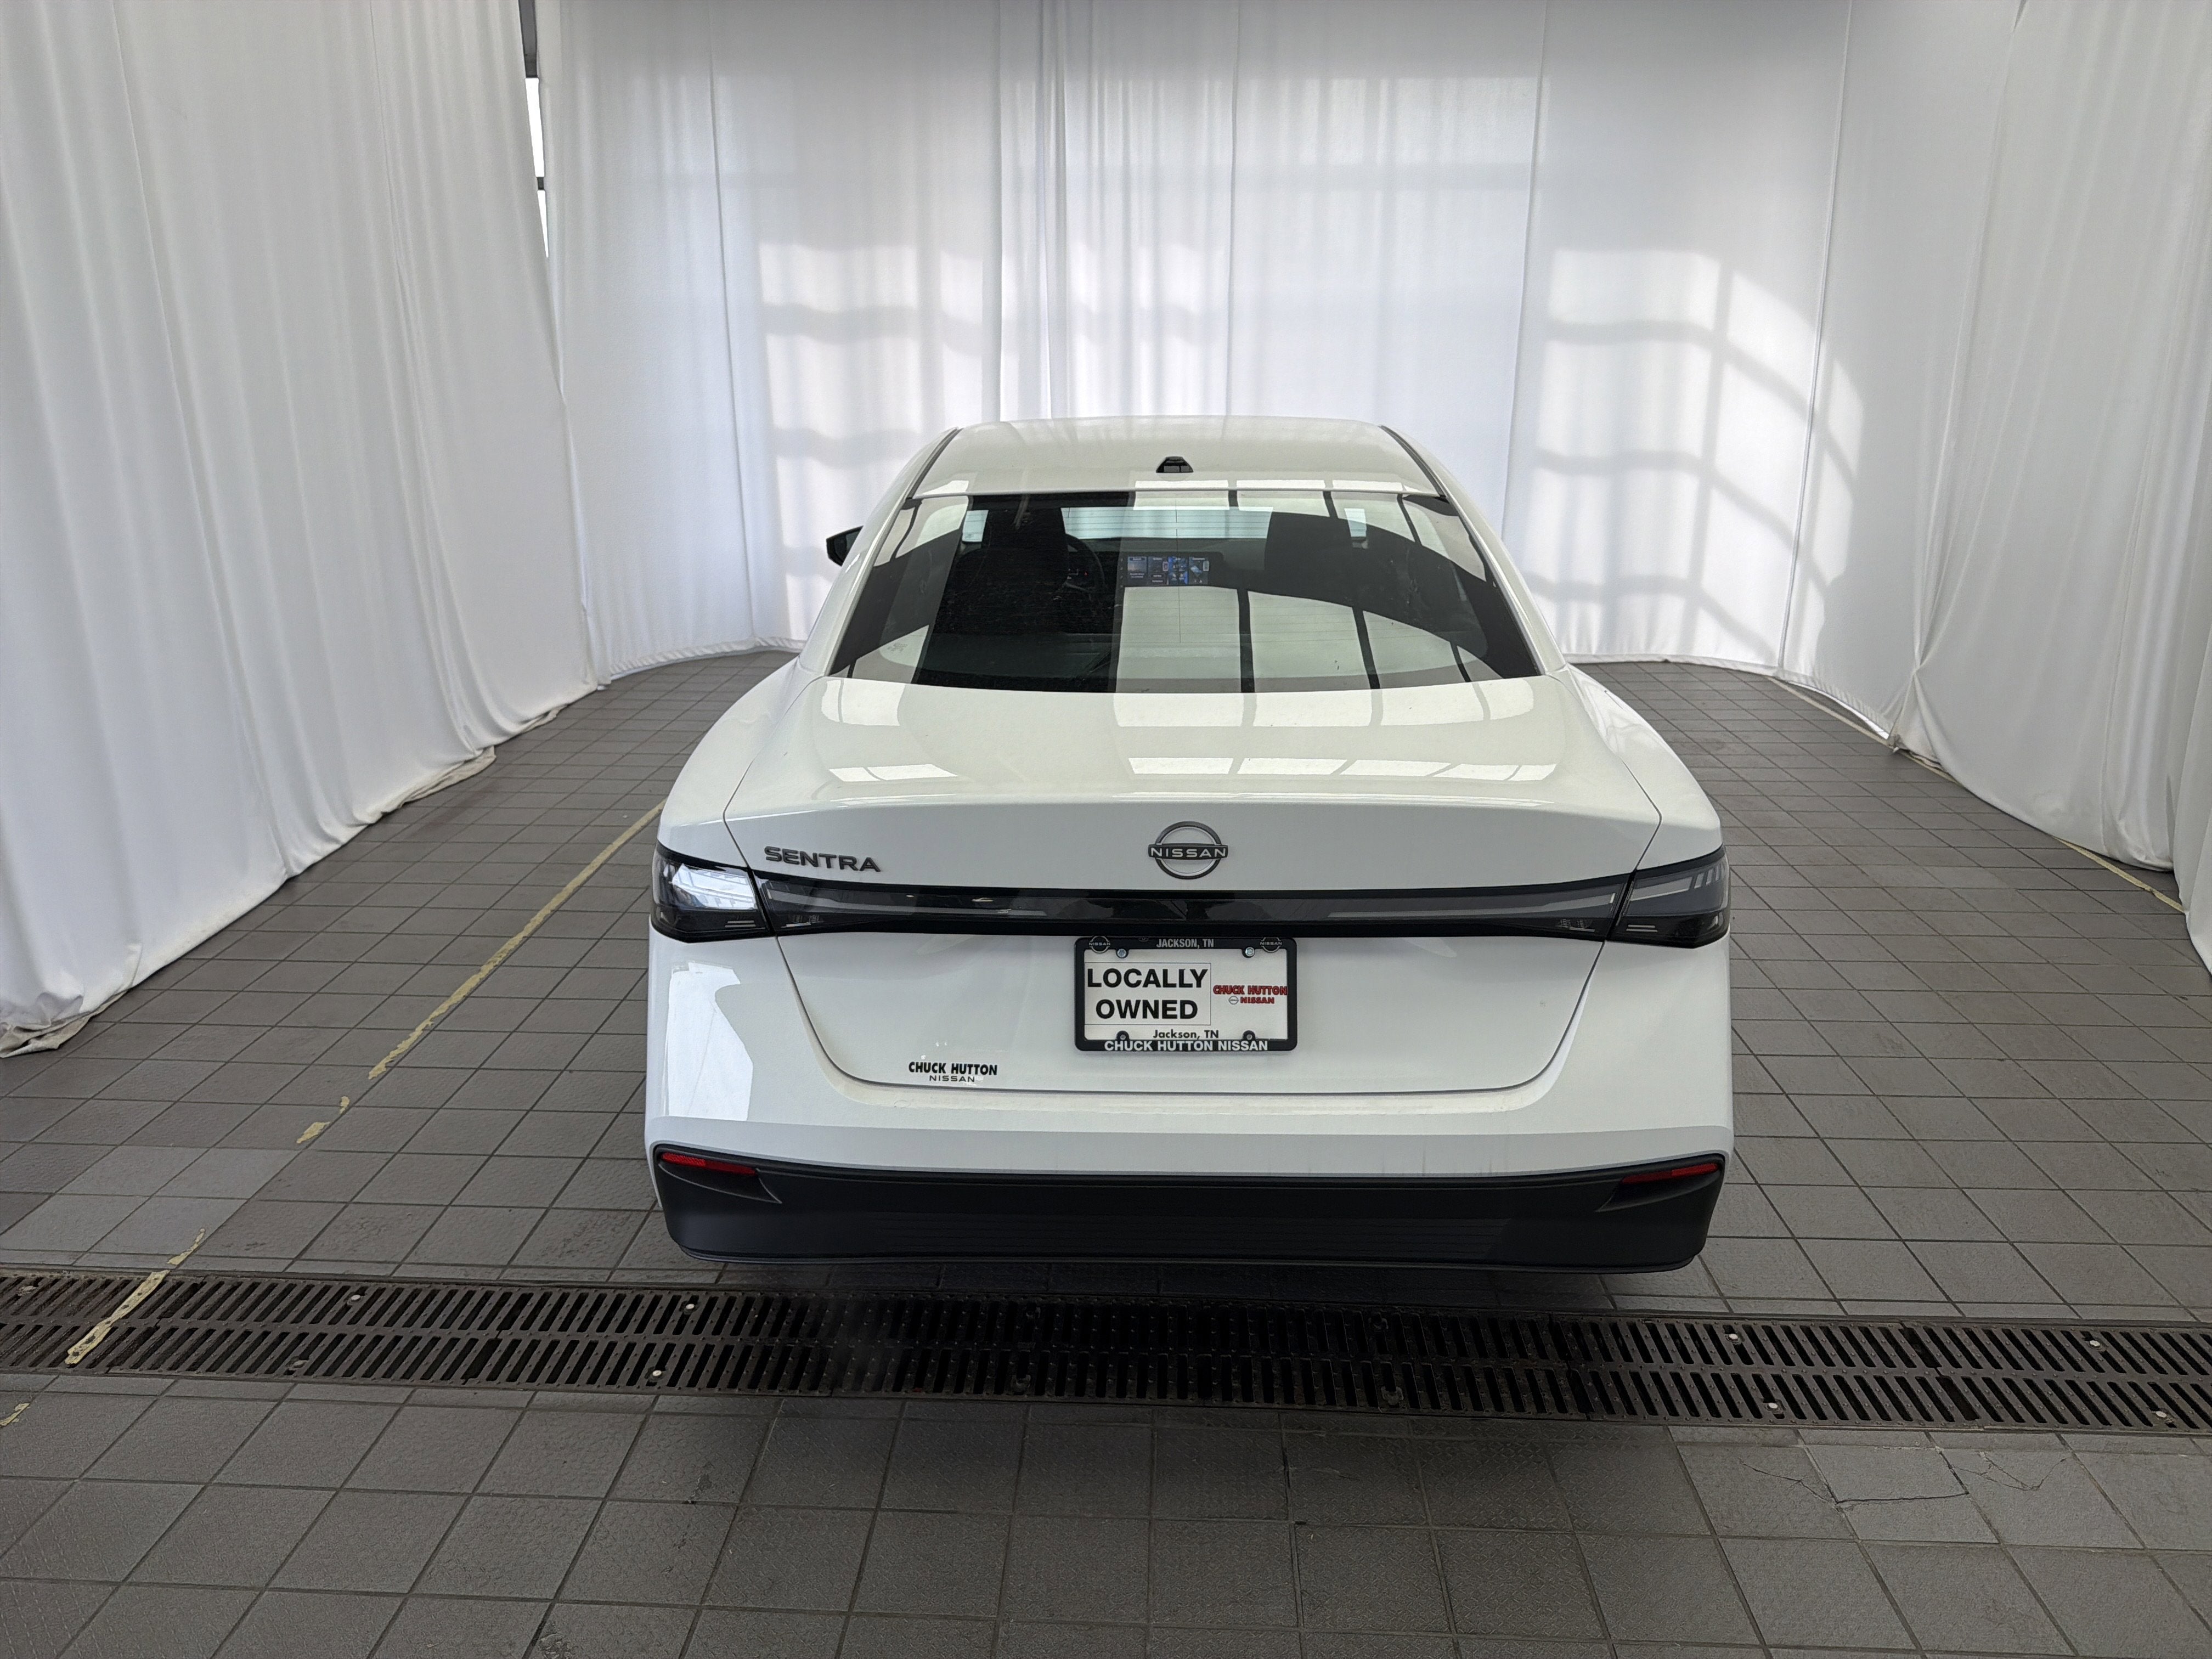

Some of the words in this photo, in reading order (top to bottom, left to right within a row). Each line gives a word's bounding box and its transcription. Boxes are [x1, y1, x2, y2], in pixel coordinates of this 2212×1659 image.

[1151, 848, 1226, 857] NISSAN
[764, 846, 881, 872] SENTRA
[1156, 938, 1199, 949] JACKSON,
[1203, 938, 1214, 947] TN
[1087, 968, 1208, 988] LOCALLY
[1213, 985, 1245, 995] CHUCK
[1248, 985, 1288, 995] HUTTON
[1096, 999, 1198, 1019] OWNED
[1153, 1029, 1200, 1040] Jackson,
[1204, 1030, 1219, 1039] TN
[1104, 1040, 1153, 1051] CHUCK
[1157, 1040, 1214, 1051] HUTTON
[1218, 1040, 1268, 1051] NISSAN
[909, 1062, 946, 1074] CHUCK
[951, 1063, 997, 1075] HUTTON
